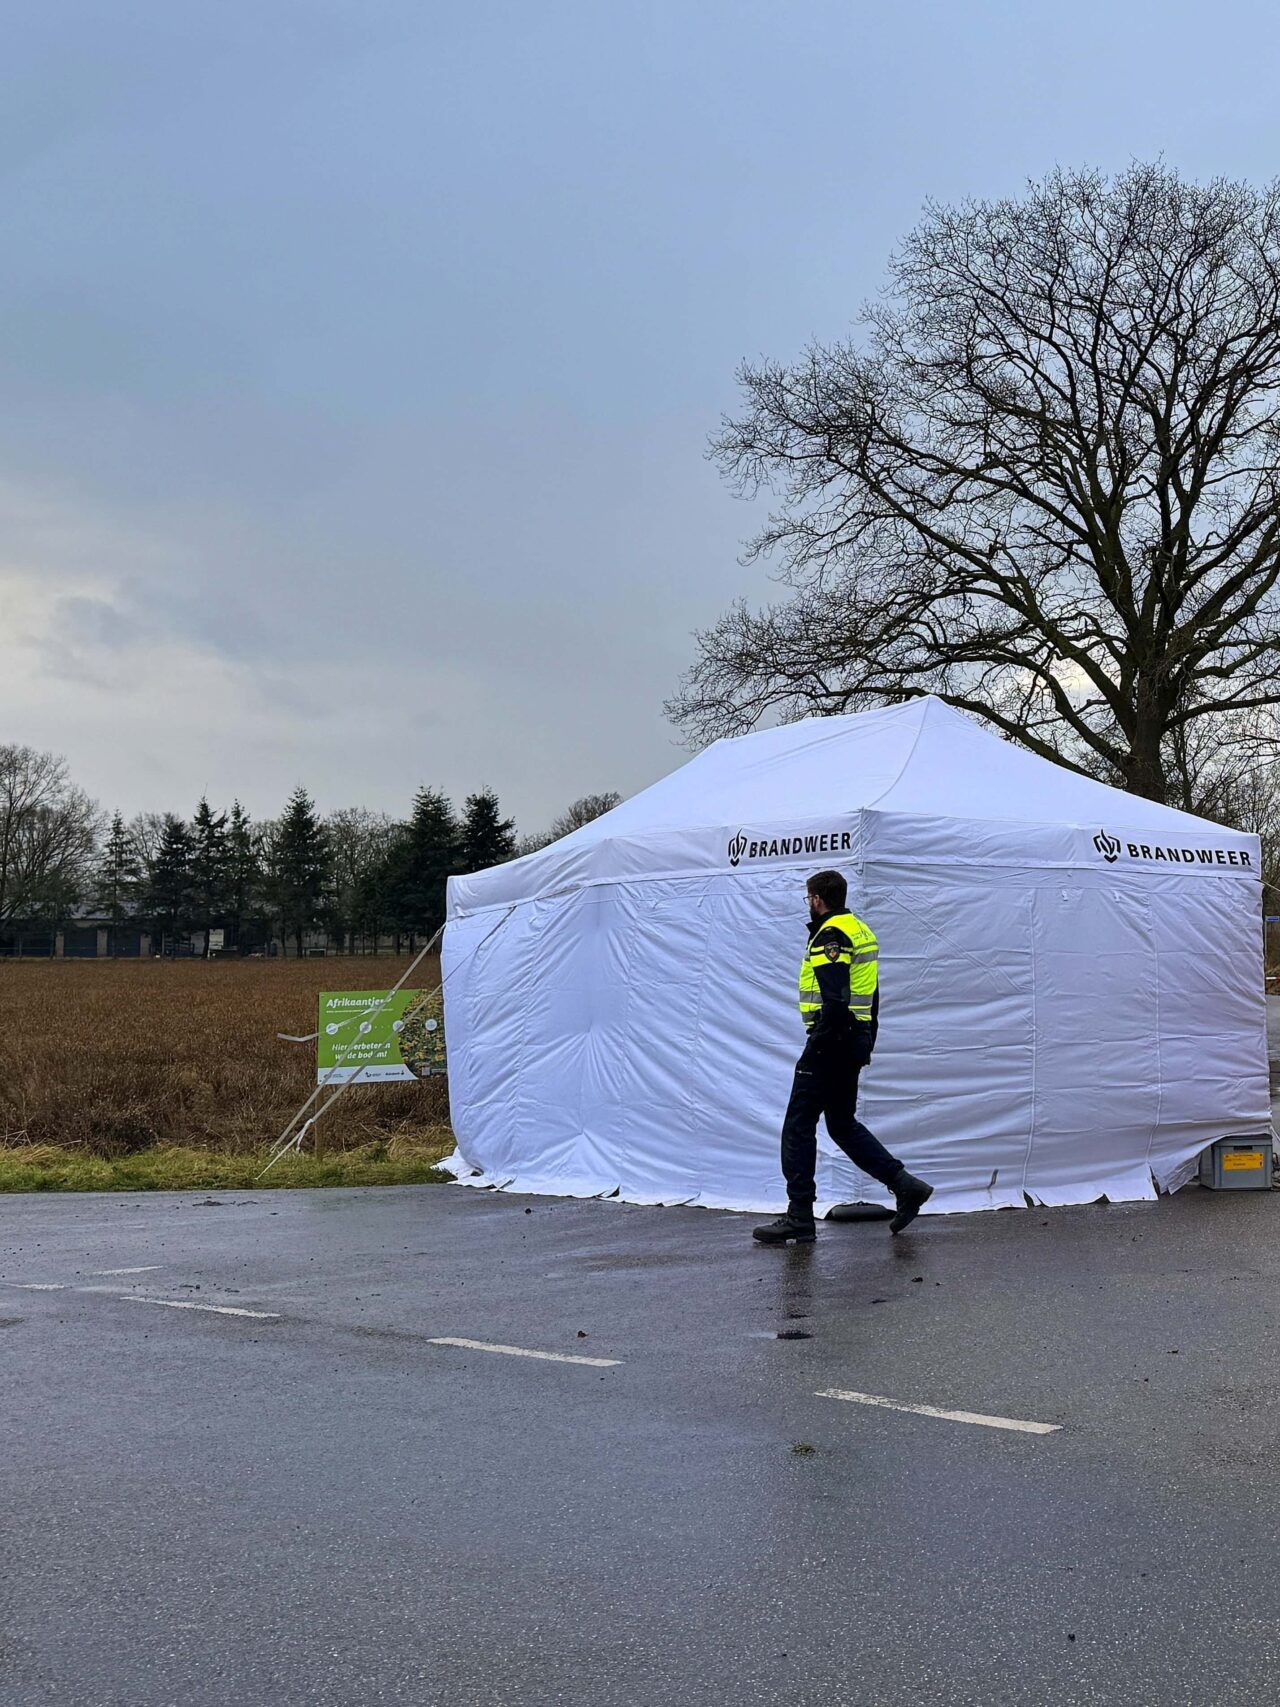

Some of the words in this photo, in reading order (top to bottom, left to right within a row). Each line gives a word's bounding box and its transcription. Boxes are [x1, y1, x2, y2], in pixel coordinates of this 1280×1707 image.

[748, 832, 851, 858] BRANDWEER
[1126, 843, 1252, 866] BRANDWEER
[332, 1042, 348, 1051] Hier
[351, 1042, 391, 1051] erbetern
[357, 1050, 388, 1059] bodm!
